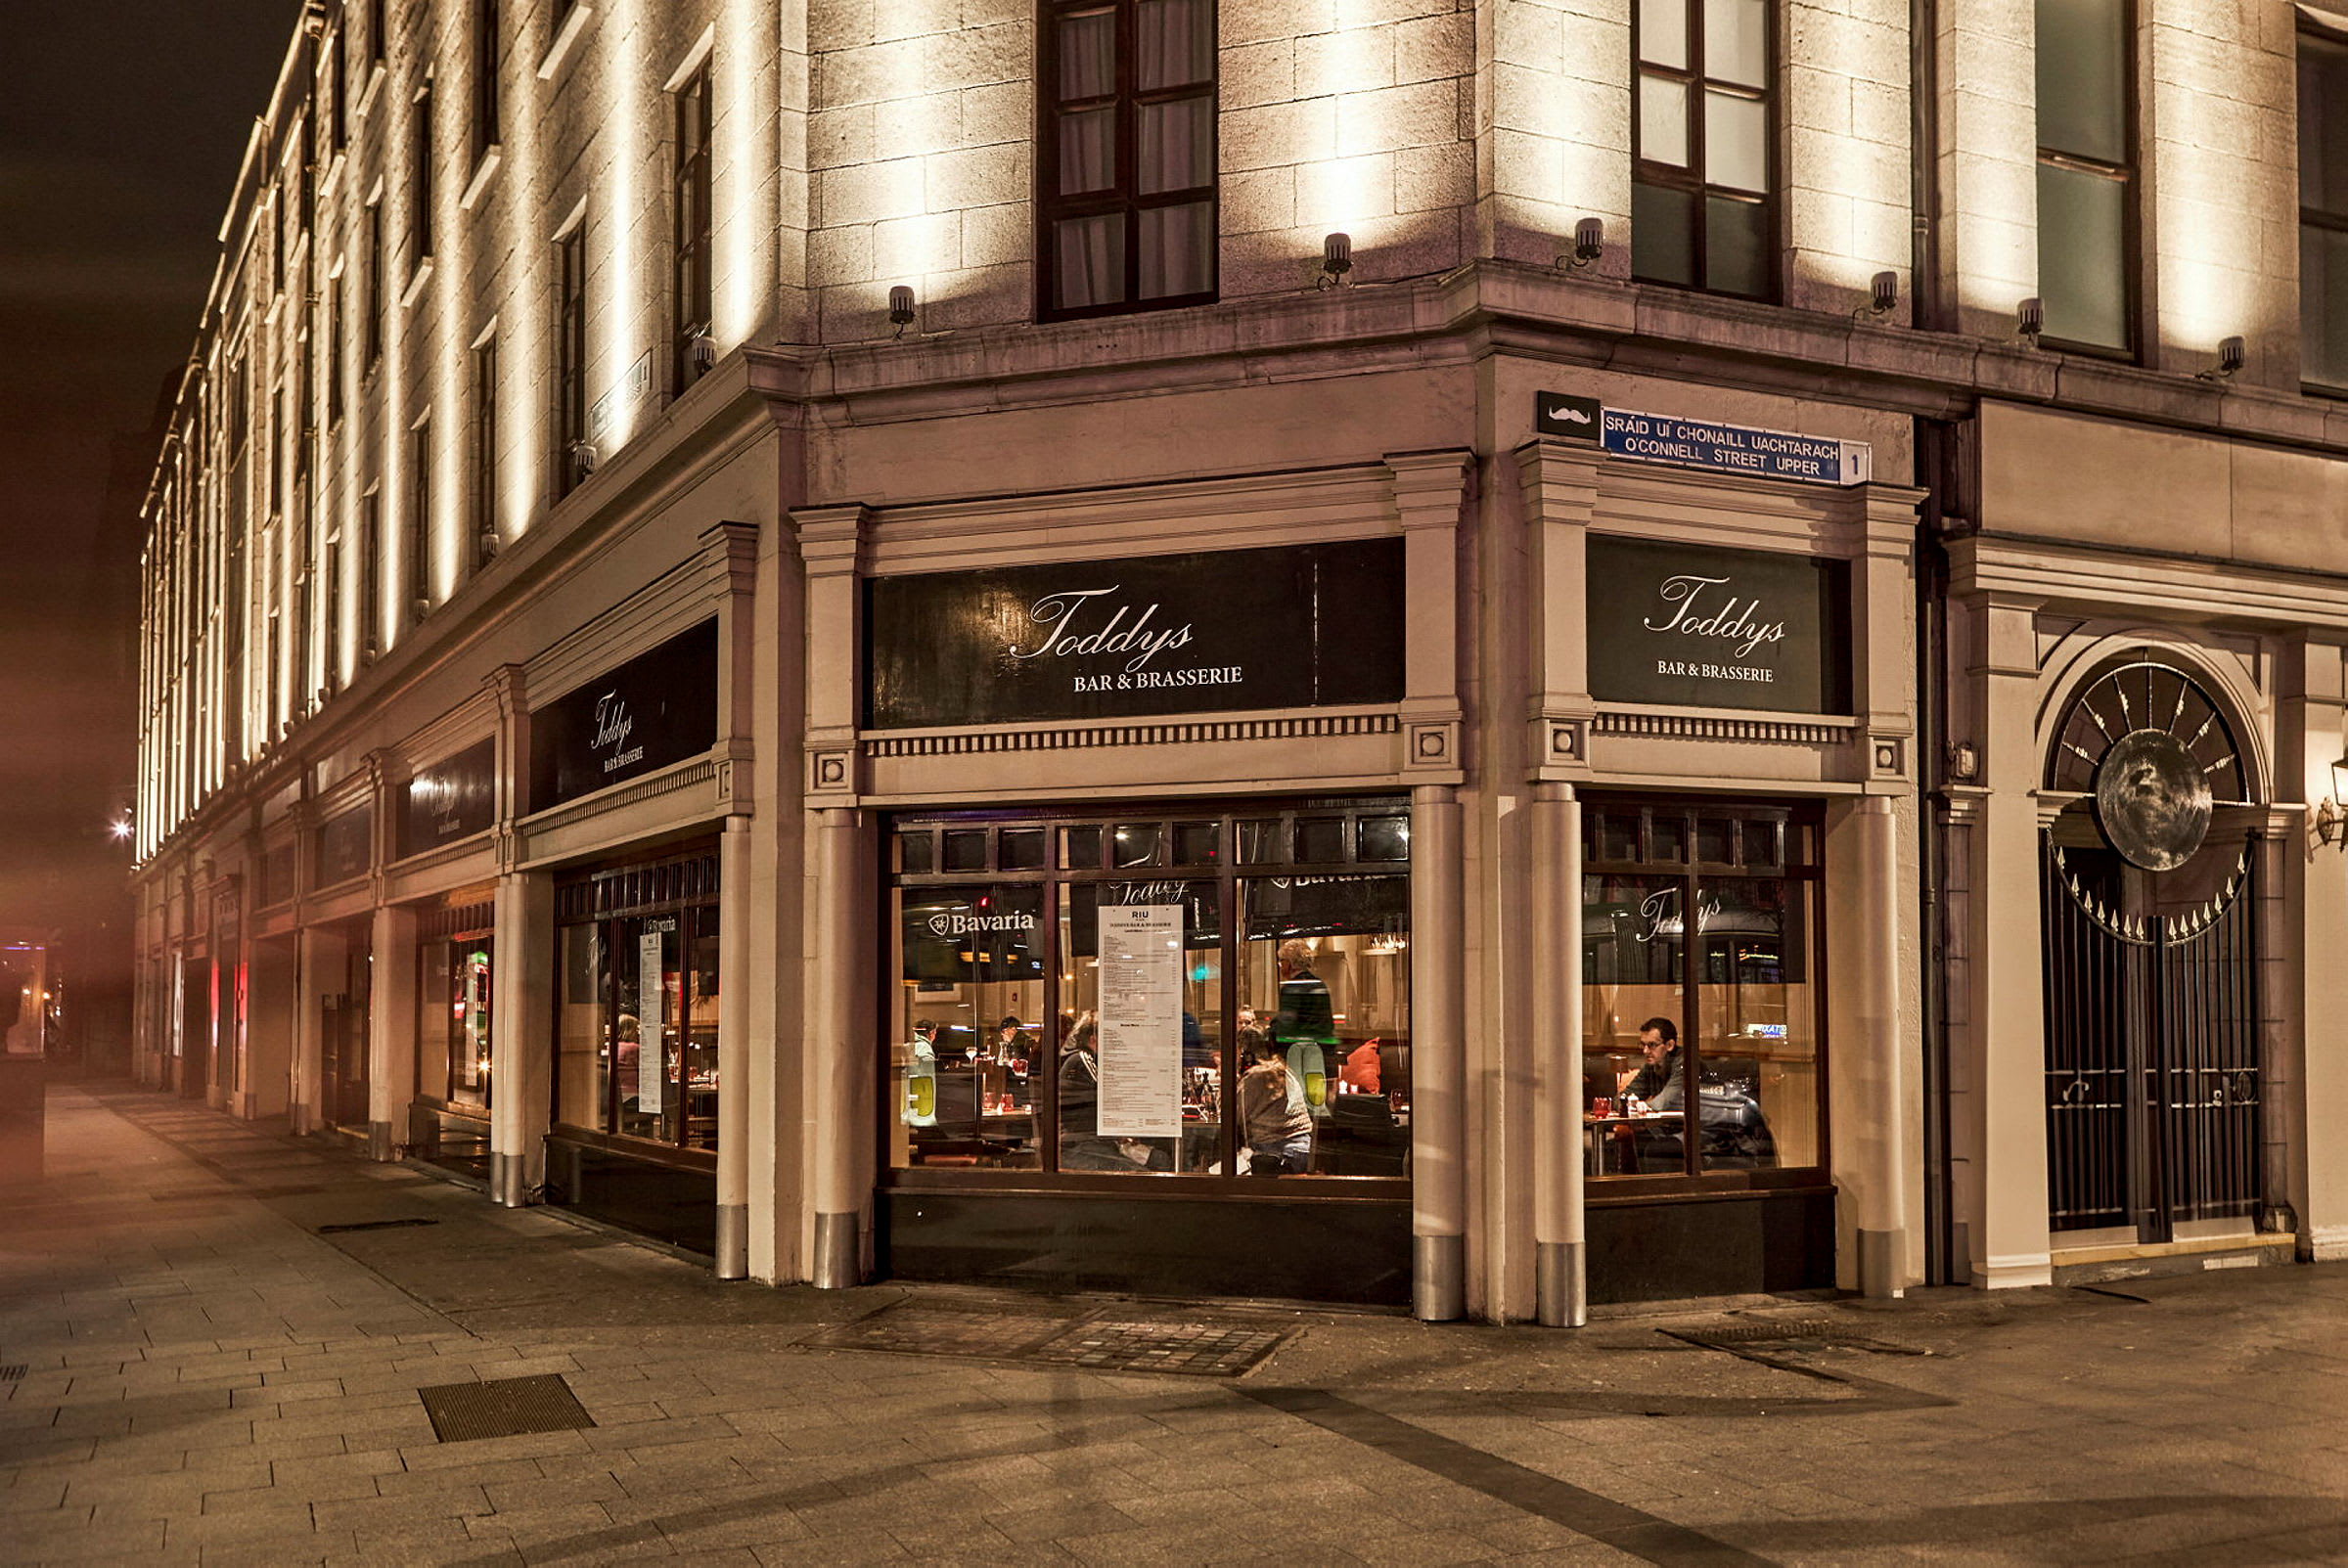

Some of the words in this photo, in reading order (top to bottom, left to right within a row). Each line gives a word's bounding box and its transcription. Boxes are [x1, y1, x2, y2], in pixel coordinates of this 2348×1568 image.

[1604, 415, 1649, 435] SRÁID
[1677, 426, 1745, 449] CHONAILL
[1751, 435, 1839, 461] UACHTARACH
[1625, 436, 1703, 460] O'CONNELL
[1714, 448, 1767, 469] STREET
[1776, 457, 1821, 476] UPPER
[1851, 454, 1859, 475] 1
[1009, 584, 1194, 672] Toddys
[1644, 575, 1785, 658] Toddys
[1073, 674, 1113, 693] BAR
[1117, 673, 1132, 689] &
[1136, 666, 1243, 690] BRASSERIE
[1657, 660, 1686, 677] BAR
[1689, 663, 1698, 677] &
[1701, 664, 1774, 683] BRASSERIE
[951, 910, 1035, 934] Bavaria
